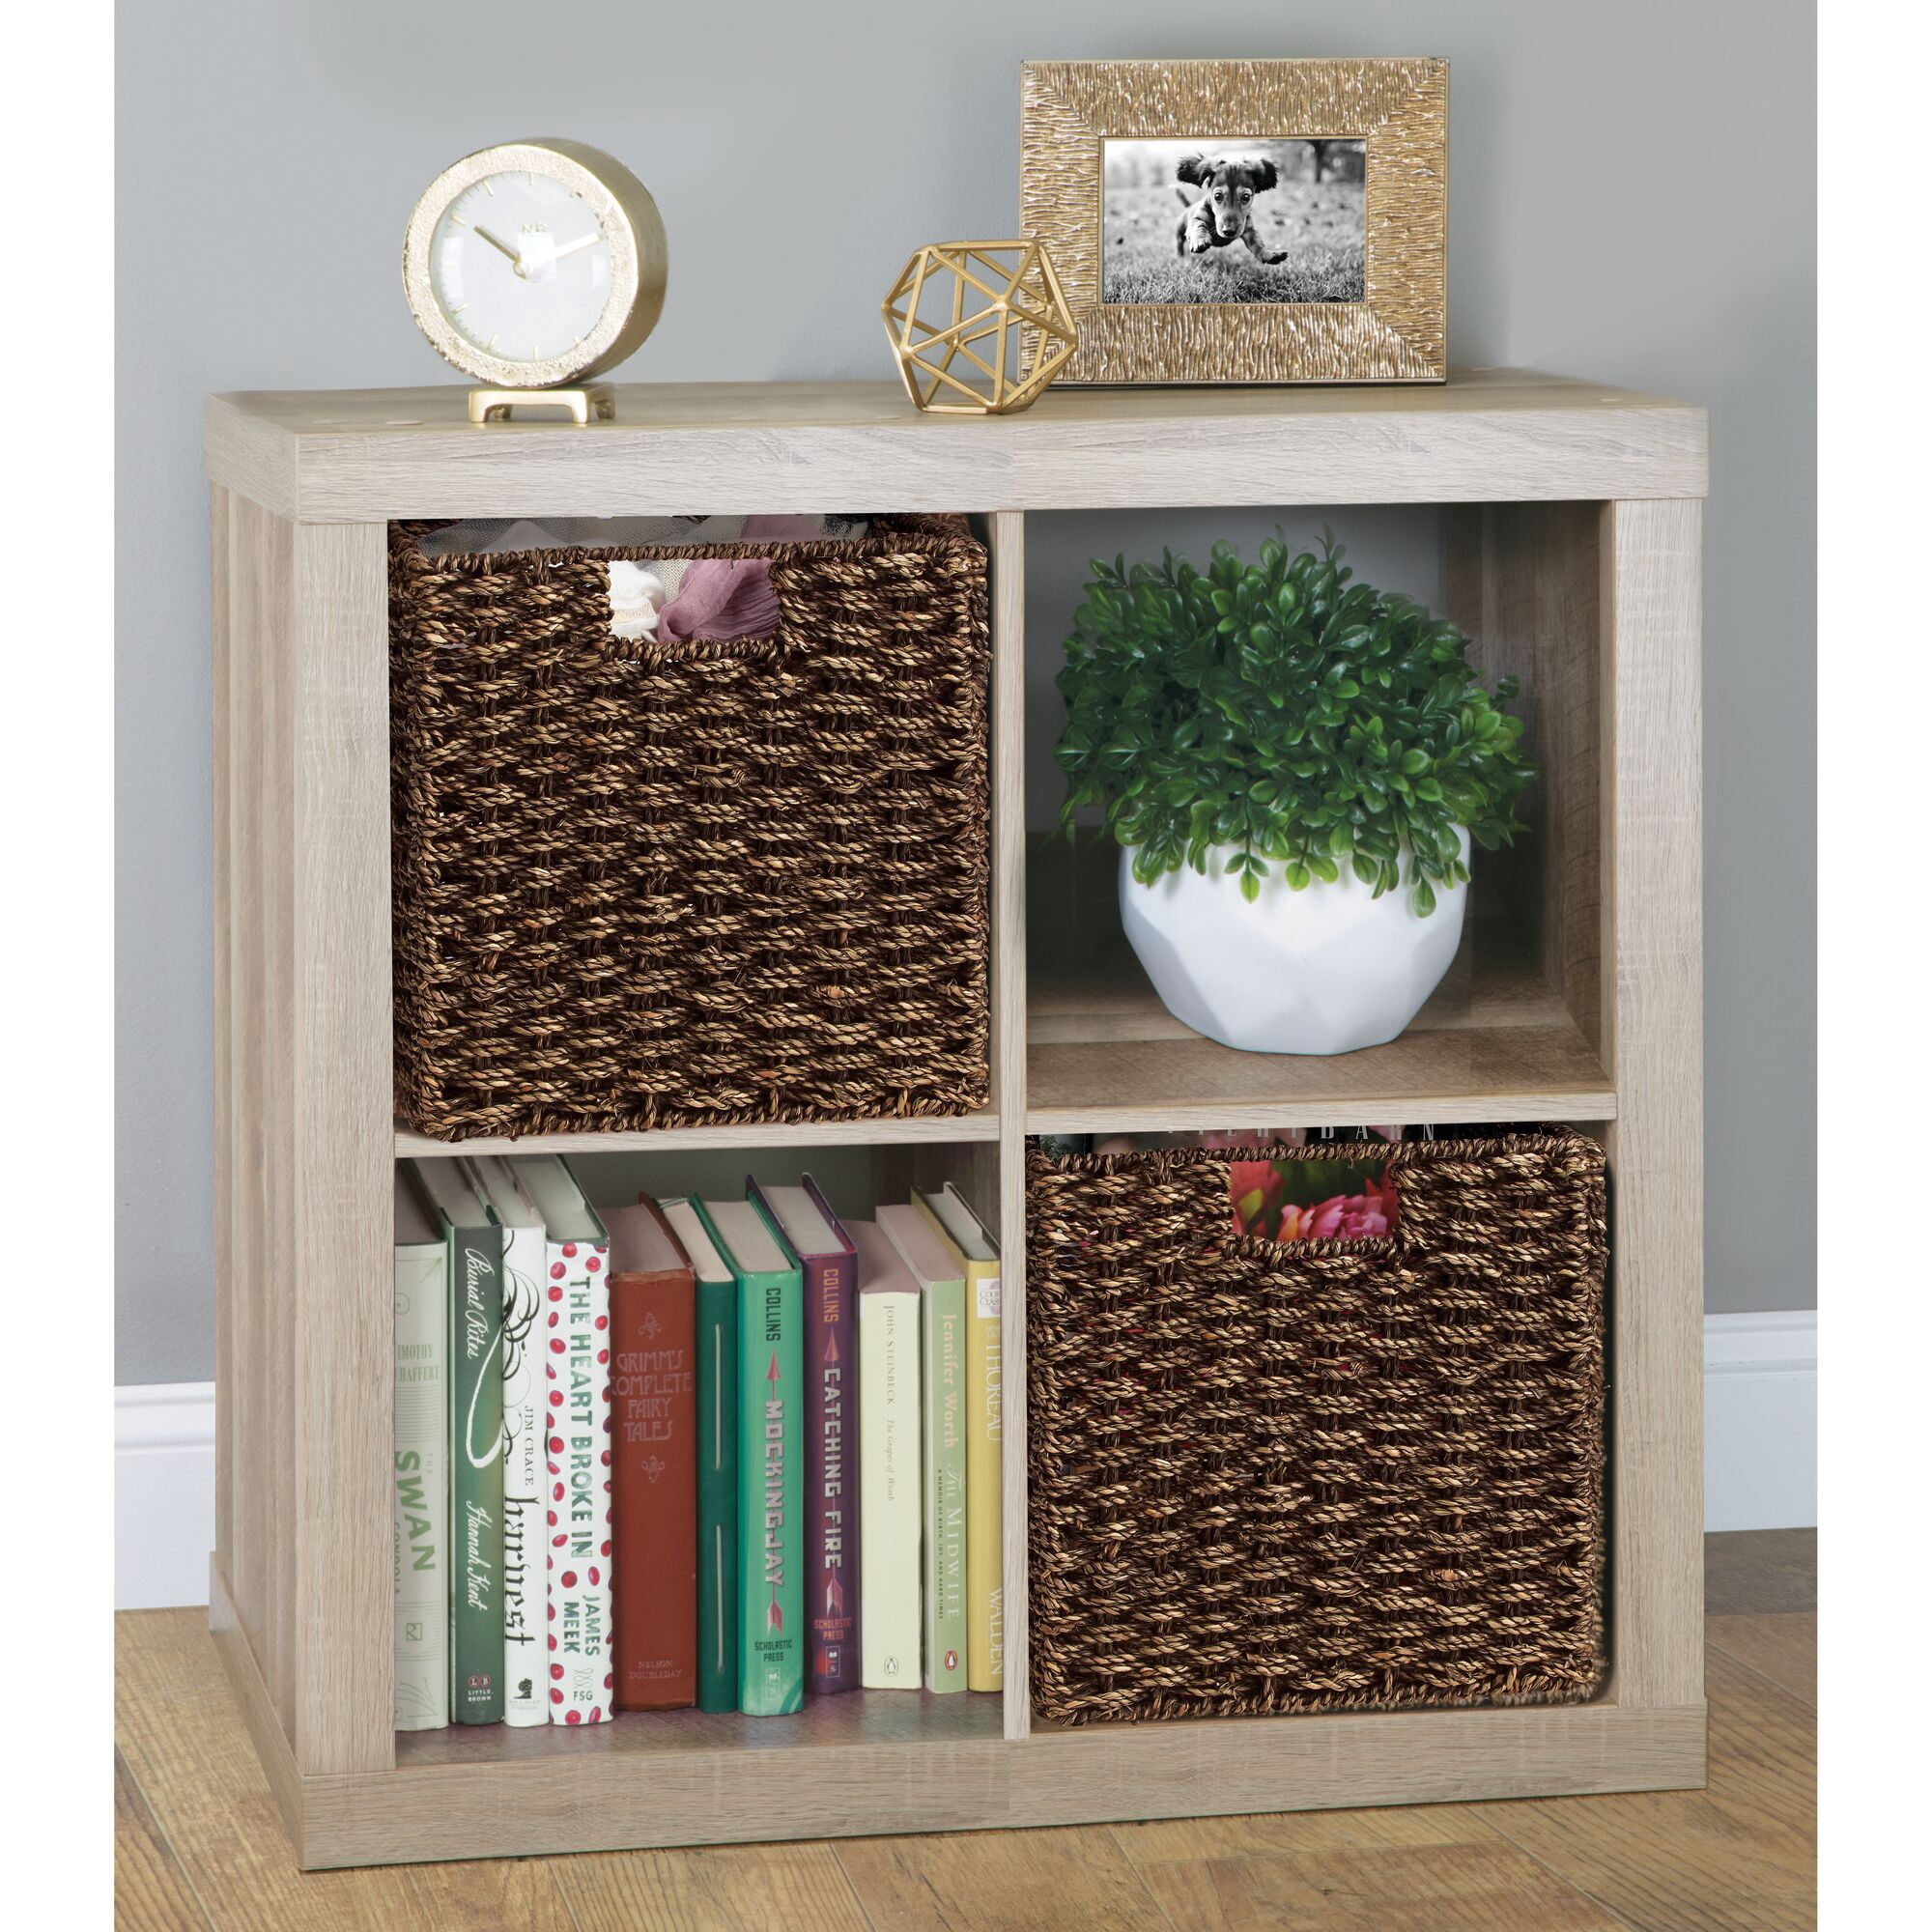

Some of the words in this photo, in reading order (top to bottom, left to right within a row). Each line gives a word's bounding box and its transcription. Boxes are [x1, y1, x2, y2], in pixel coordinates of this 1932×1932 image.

[465, 1248, 495, 1311] Burial
[570, 1276, 590, 1324] THE
[824, 1268, 838, 1322] COLLINS
[466, 1310, 489, 1359] Rites
[766, 1288, 781, 1342] COLLINS
[884, 1305, 895, 1335] JOHN
[396, 1344, 433, 1360] IMOTHY
[616, 1350, 684, 1373] GRIMM'S
[886, 1340, 895, 1405] STEINBECK
[943, 1314, 958, 1385] Jennifer
[570, 1334, 592, 1426] HEART
[611, 1372, 693, 1396] COMPLETE
[525, 1406, 533, 1430] JIM
[623, 1420, 673, 1442] TALES
[628, 1397, 672, 1419] FAIRY
[824, 1368, 841, 1498] CATCHING
[944, 1391, 958, 1449] Worth
[525, 1438, 533, 1486] CRACE
[571, 1436, 592, 1521] BROKE
[394, 1451, 436, 1571] SWAN
[765, 1401, 783, 1586] MOCKINGJAY
[466, 1500, 493, 1568] Hannah
[571, 1531, 593, 1558] IN
[825, 1510, 841, 1569] FIRE
[468, 1567, 491, 1610] Kent
[948, 1508, 962, 1619] MIDWIFE
[563, 1602, 580, 1653] MEEK
[582, 1595, 601, 1656] JAMES
[754, 1639, 792, 1651] SCHOLASTIC
[814, 1617, 852, 1630] SCHOLASTIC
[823, 1630, 844, 1640] PRESS
[989, 1588, 1002, 1674] WALDEN
[763, 1652, 784, 1662] PRESS
[573, 1690, 593, 1701] FSG
